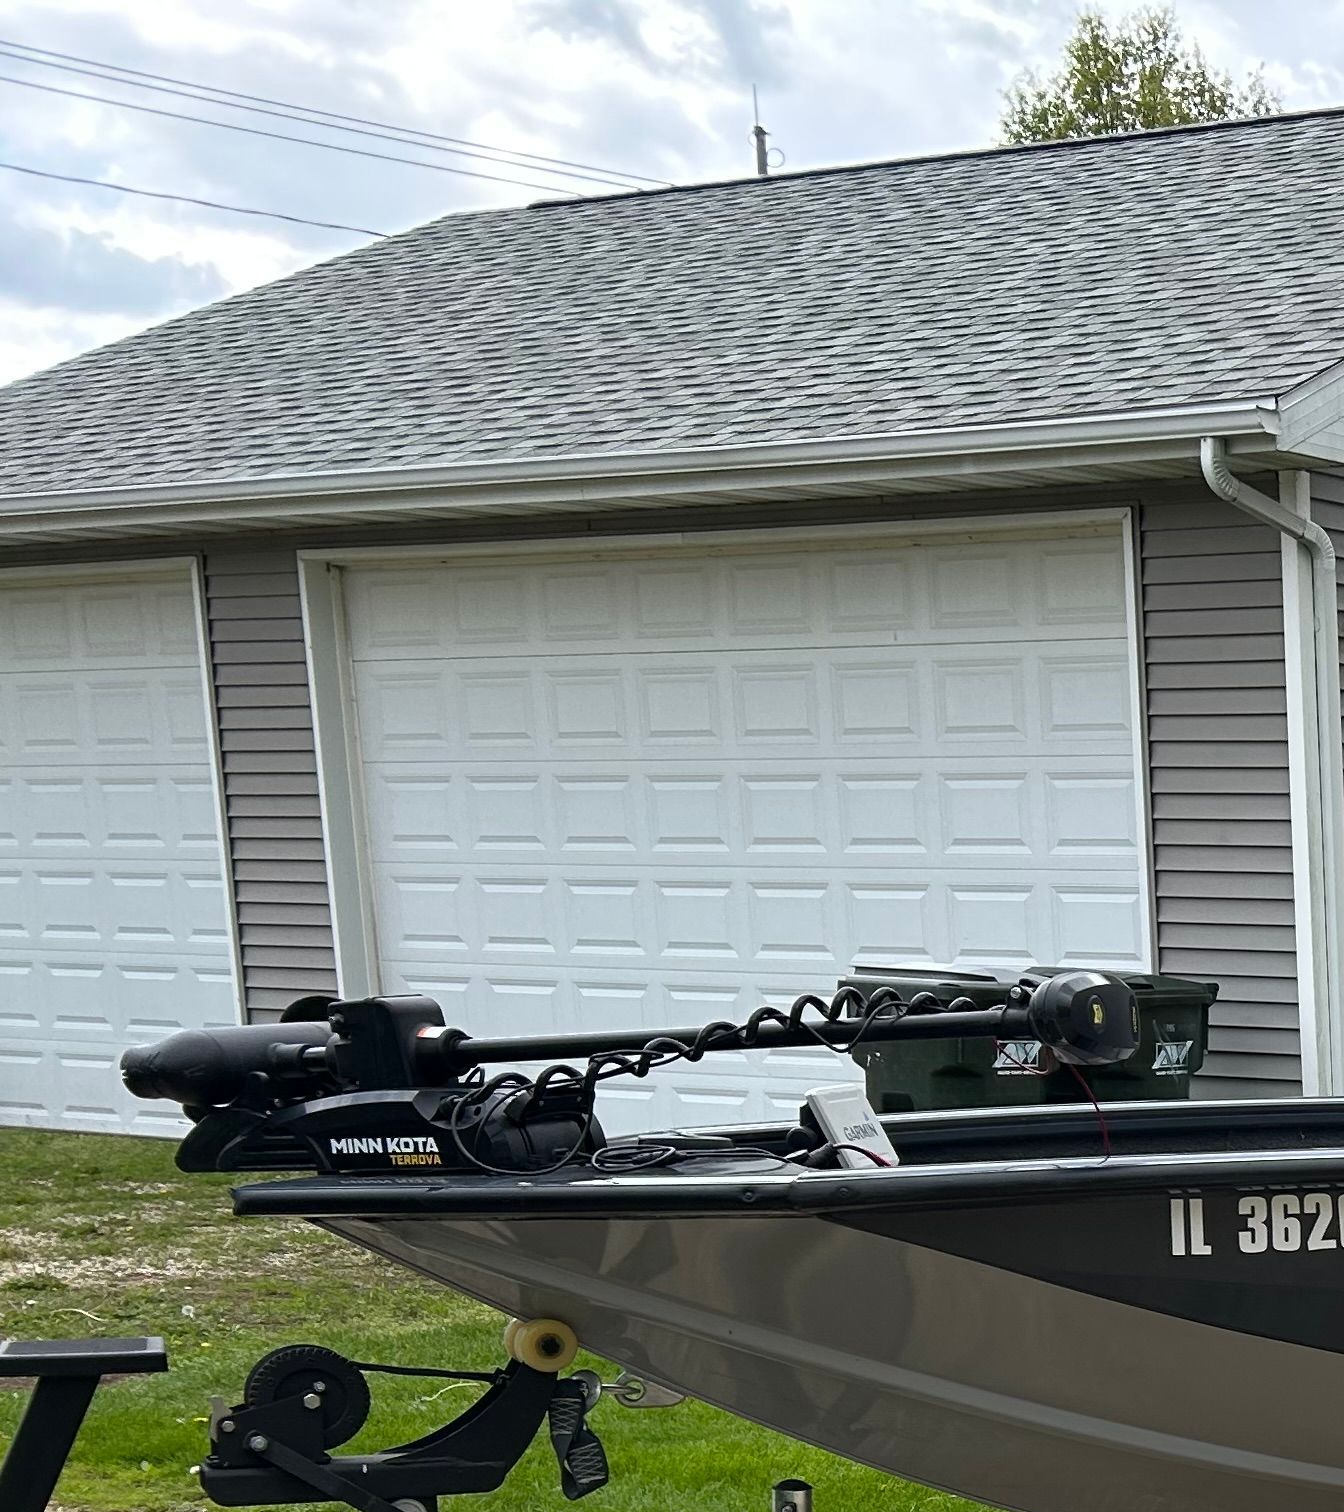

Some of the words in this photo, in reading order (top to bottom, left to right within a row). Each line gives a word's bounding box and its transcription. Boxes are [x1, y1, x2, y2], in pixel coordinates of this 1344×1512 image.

[843, 1122, 879, 1142] GARMIN
[330, 1138, 384, 1154] MINN
[386, 1137, 440, 1153] KOTA
[389, 1154, 442, 1166] TERROVA
[1170, 1198, 1212, 1256] IL
